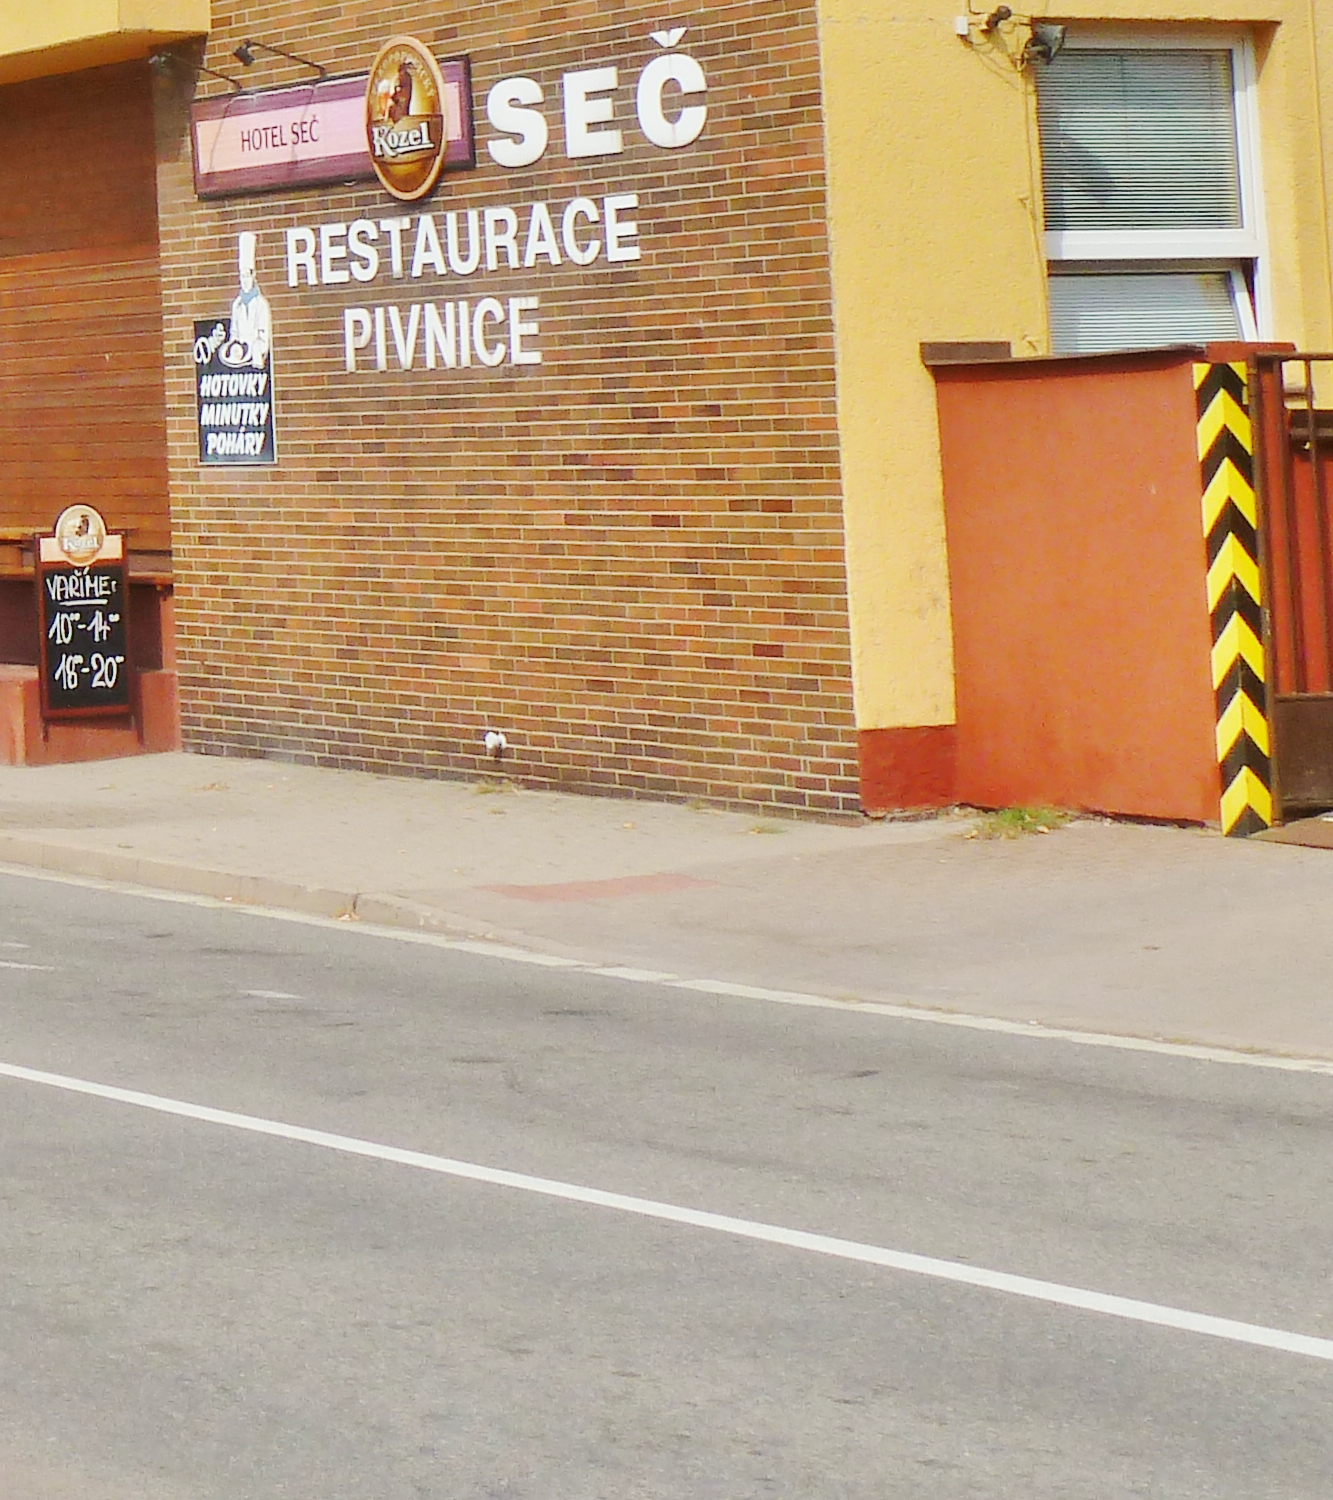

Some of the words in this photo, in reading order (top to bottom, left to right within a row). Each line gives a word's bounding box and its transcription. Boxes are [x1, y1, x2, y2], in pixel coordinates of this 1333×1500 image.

[486, 26, 708, 169] SEČ
[240, 124, 288, 152] HOTEL
[290, 113, 320, 146] SEČ
[373, 121, 435, 157] Kozel
[286, 193, 642, 288] RESTAURACE
[343, 296, 543, 373] PIVNICE
[200, 372, 268, 397] HOTOVKY
[200, 402, 269, 427] MINUTKY
[206, 427, 265, 456] POHÁRY
